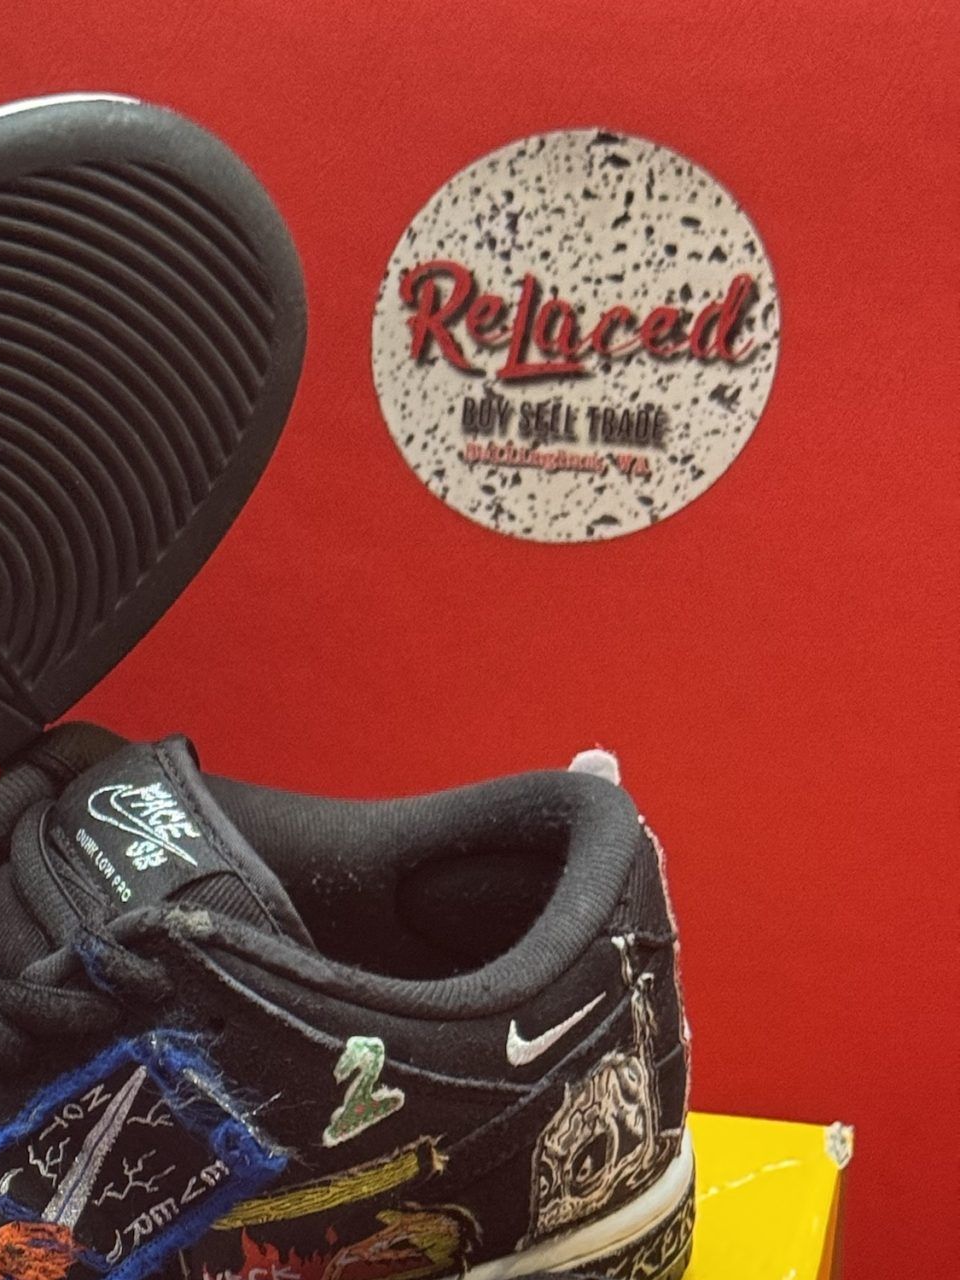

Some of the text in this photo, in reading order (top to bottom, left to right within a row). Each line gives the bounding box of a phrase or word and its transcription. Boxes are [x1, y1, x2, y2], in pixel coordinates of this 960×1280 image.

[399, 260, 758, 382] ReLaced
[462, 397, 666, 446] BUY SELL TRADE
[76, 828, 132, 902] DUNK LOW PRO
